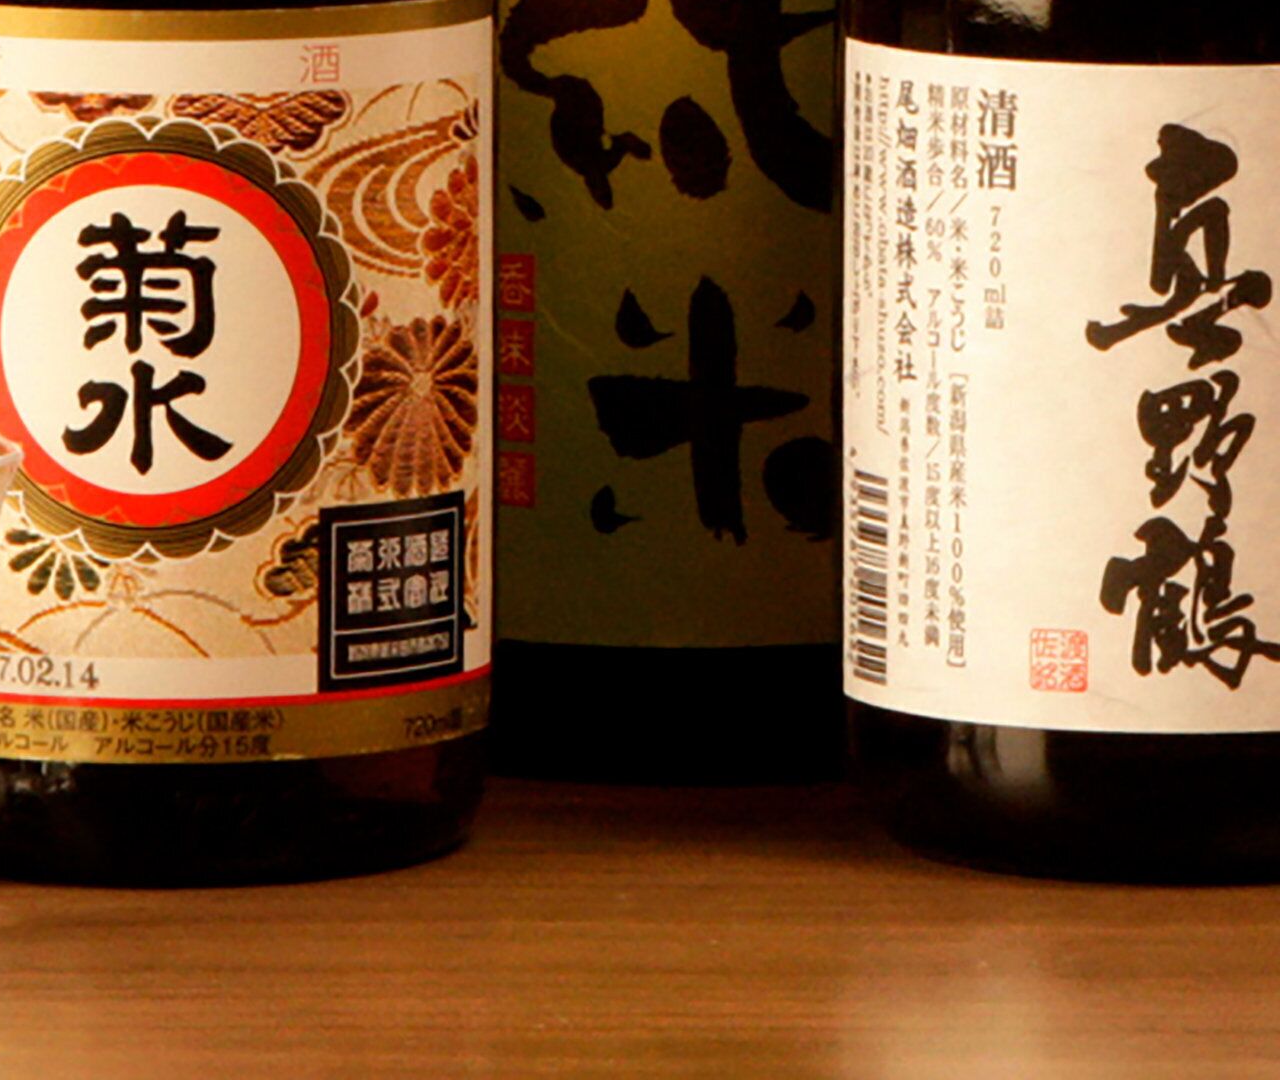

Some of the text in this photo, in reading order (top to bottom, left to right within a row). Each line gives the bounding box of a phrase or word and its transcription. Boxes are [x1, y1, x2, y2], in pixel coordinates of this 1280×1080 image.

[895, 80, 920, 384] 尾畑酒造株式会社
[977, 88, 1019, 192] 清酒
[62, 209, 234, 477] 菊水
[1085, 122, 1280, 691] 真野鶴
